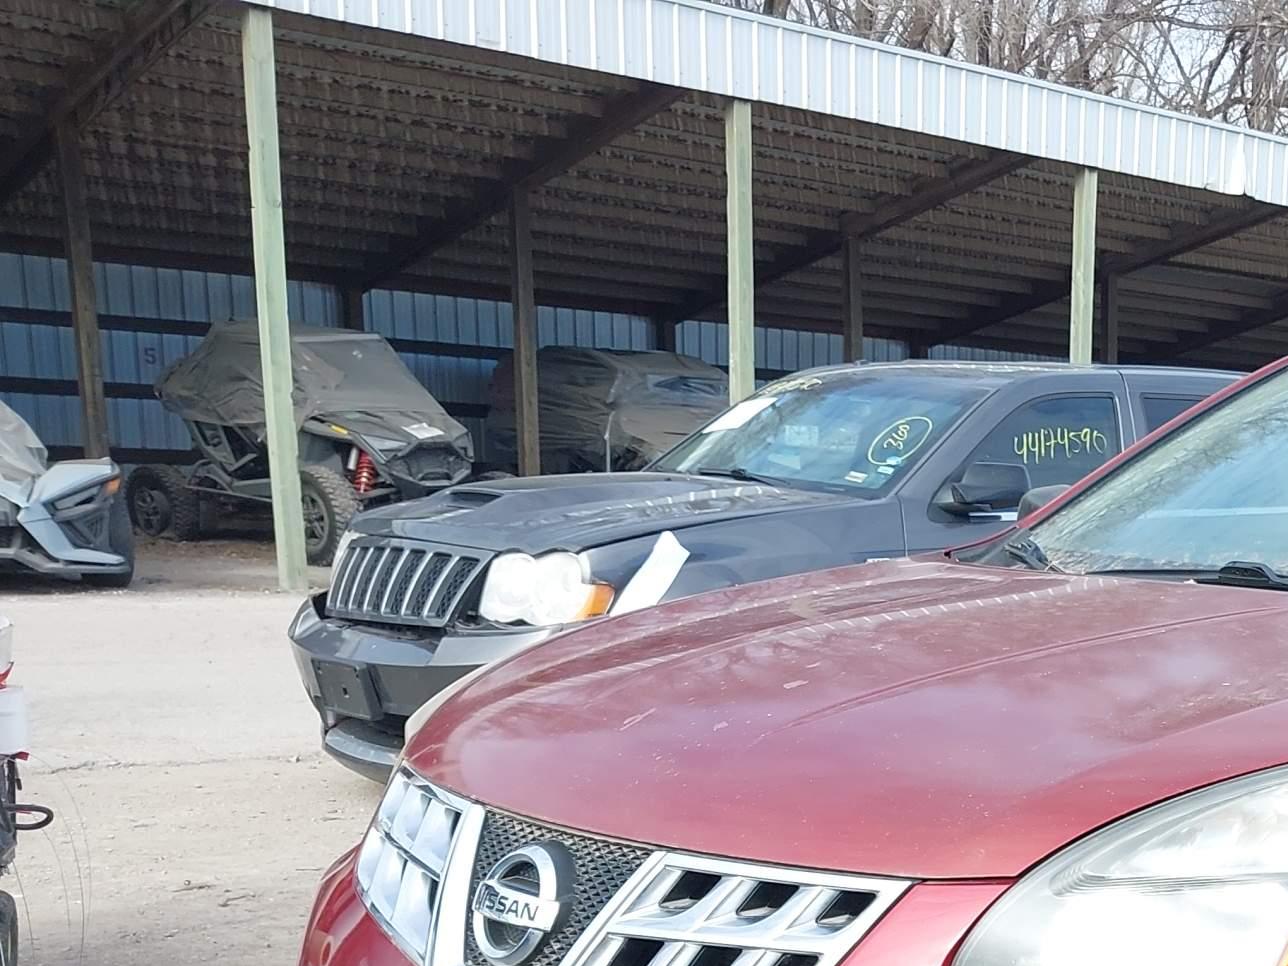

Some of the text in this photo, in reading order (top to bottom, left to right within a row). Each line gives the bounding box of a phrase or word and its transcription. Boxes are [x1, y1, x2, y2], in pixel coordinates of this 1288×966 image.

[143, 346, 157, 365] 5
[1013, 426, 1108, 465] 44174590
[475, 882, 540, 922] NISSAN
